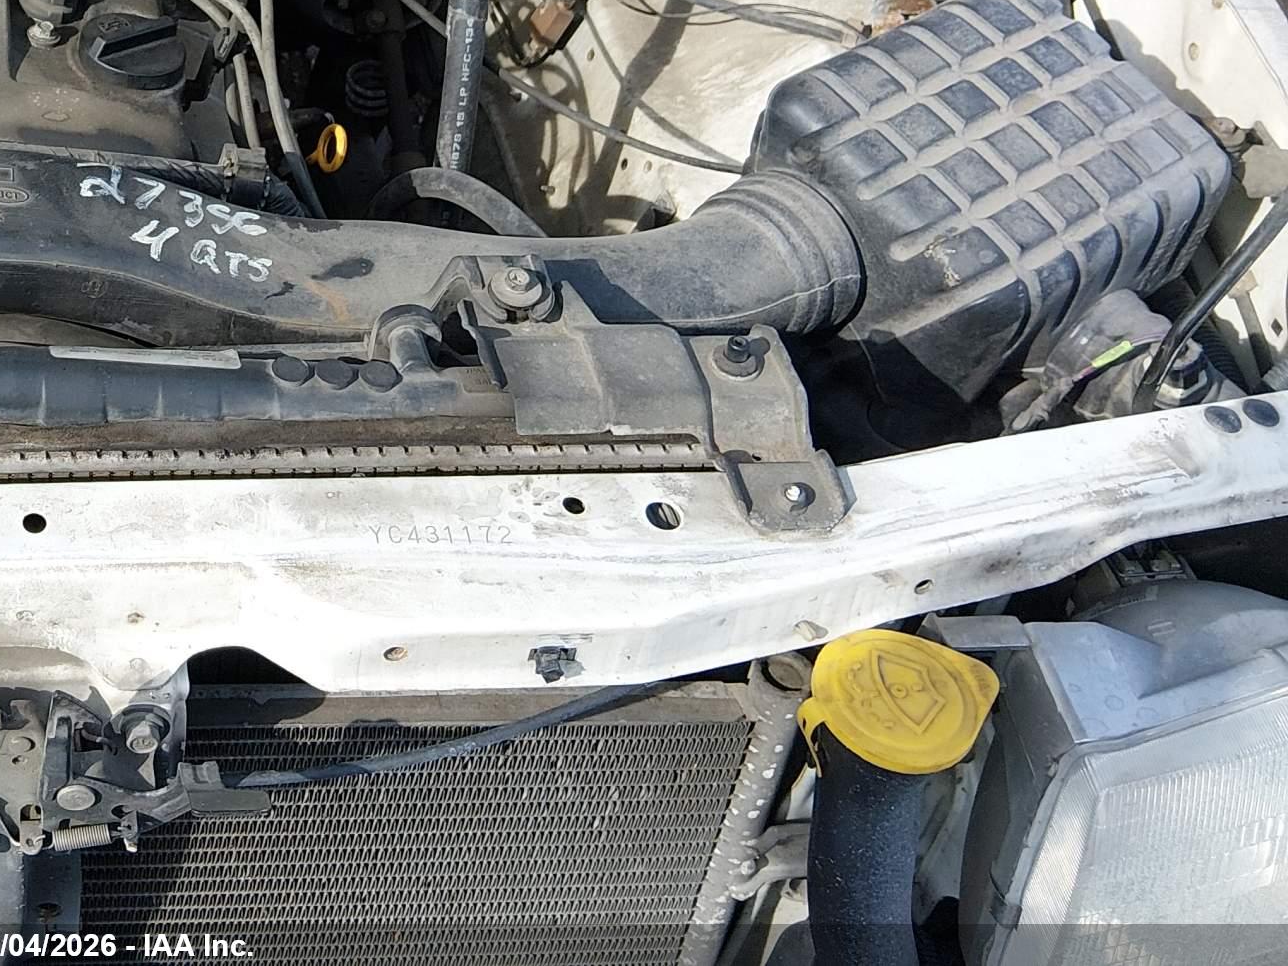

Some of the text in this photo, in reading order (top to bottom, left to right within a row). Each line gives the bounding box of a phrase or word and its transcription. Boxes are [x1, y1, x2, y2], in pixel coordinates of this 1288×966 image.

[458, 87, 469, 107] LP
[129, 219, 273, 283] 4 QTS
[368, 524, 514, 545] YC431172
